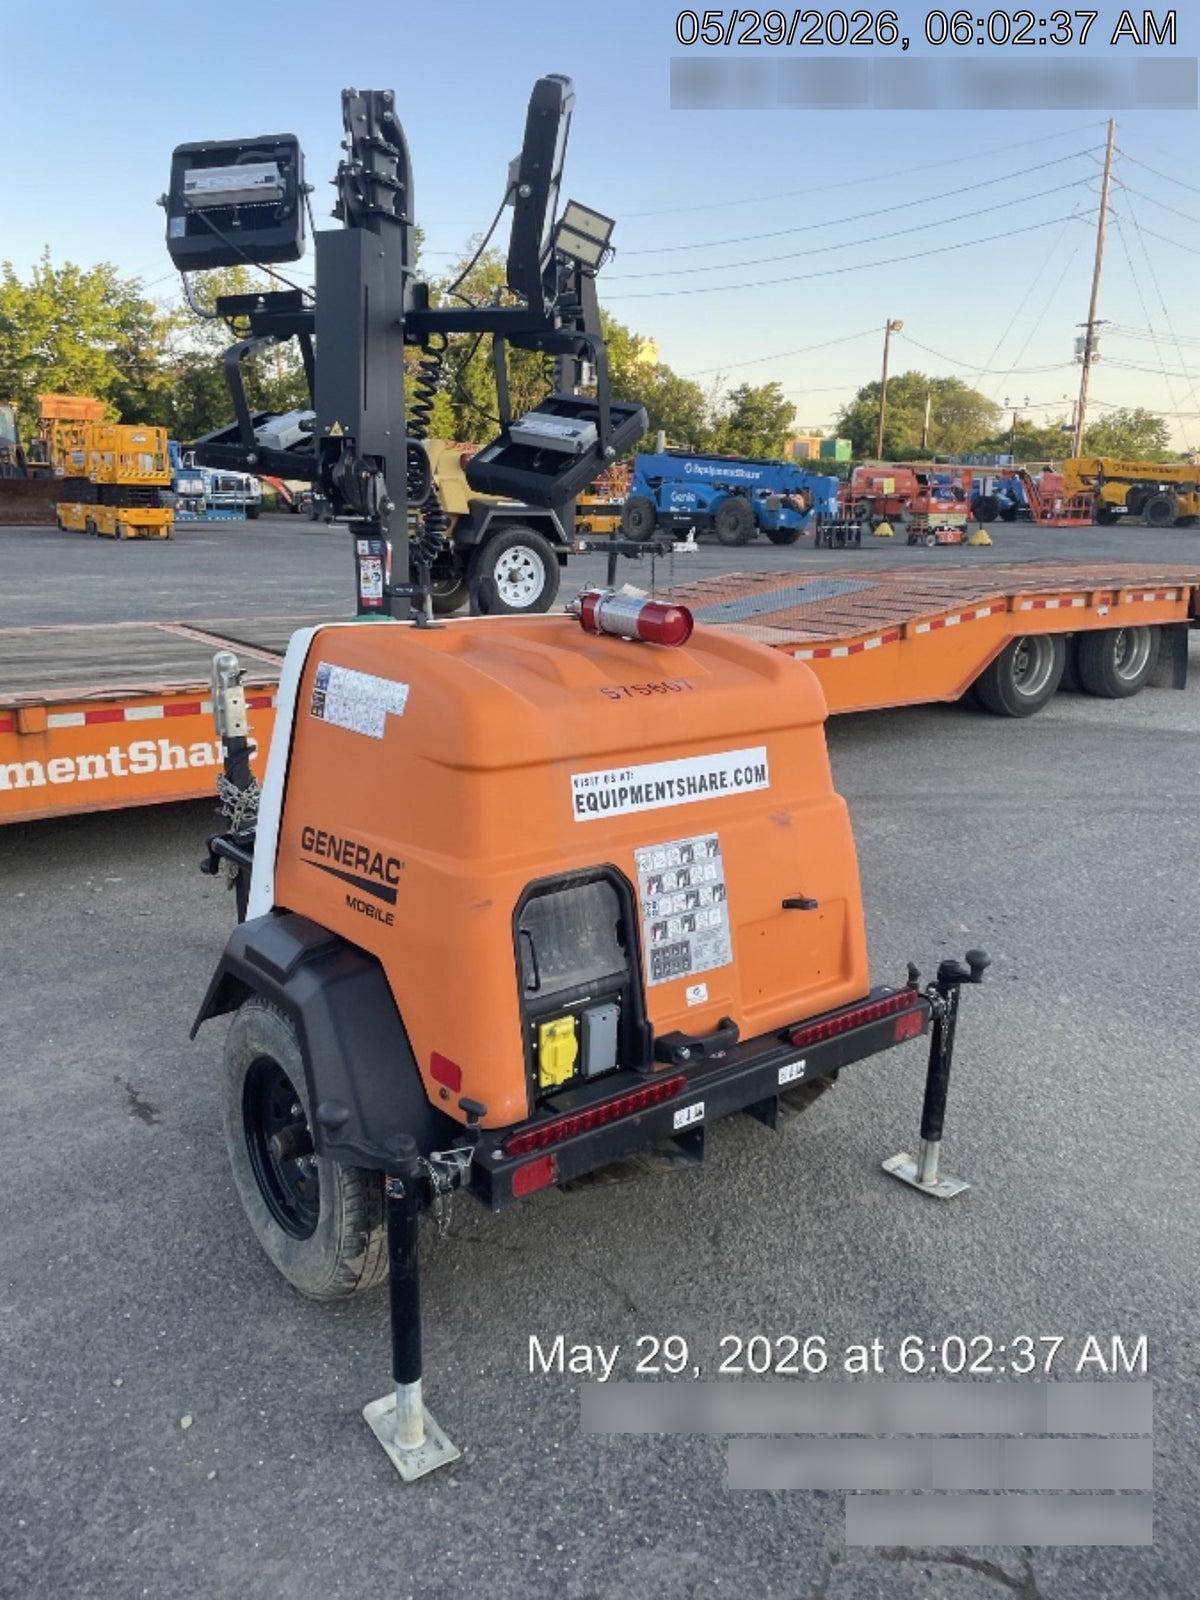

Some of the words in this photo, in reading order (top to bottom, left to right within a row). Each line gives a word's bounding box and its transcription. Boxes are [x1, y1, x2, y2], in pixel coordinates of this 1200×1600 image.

[574, 776, 599, 788] VISIT
[620, 771, 634, 781] AT:
[575, 764, 766, 813] EQUIPMENTSHARE.COM
[301, 826, 401, 885] GENERAC
[345, 894, 395, 927] MOBILE
